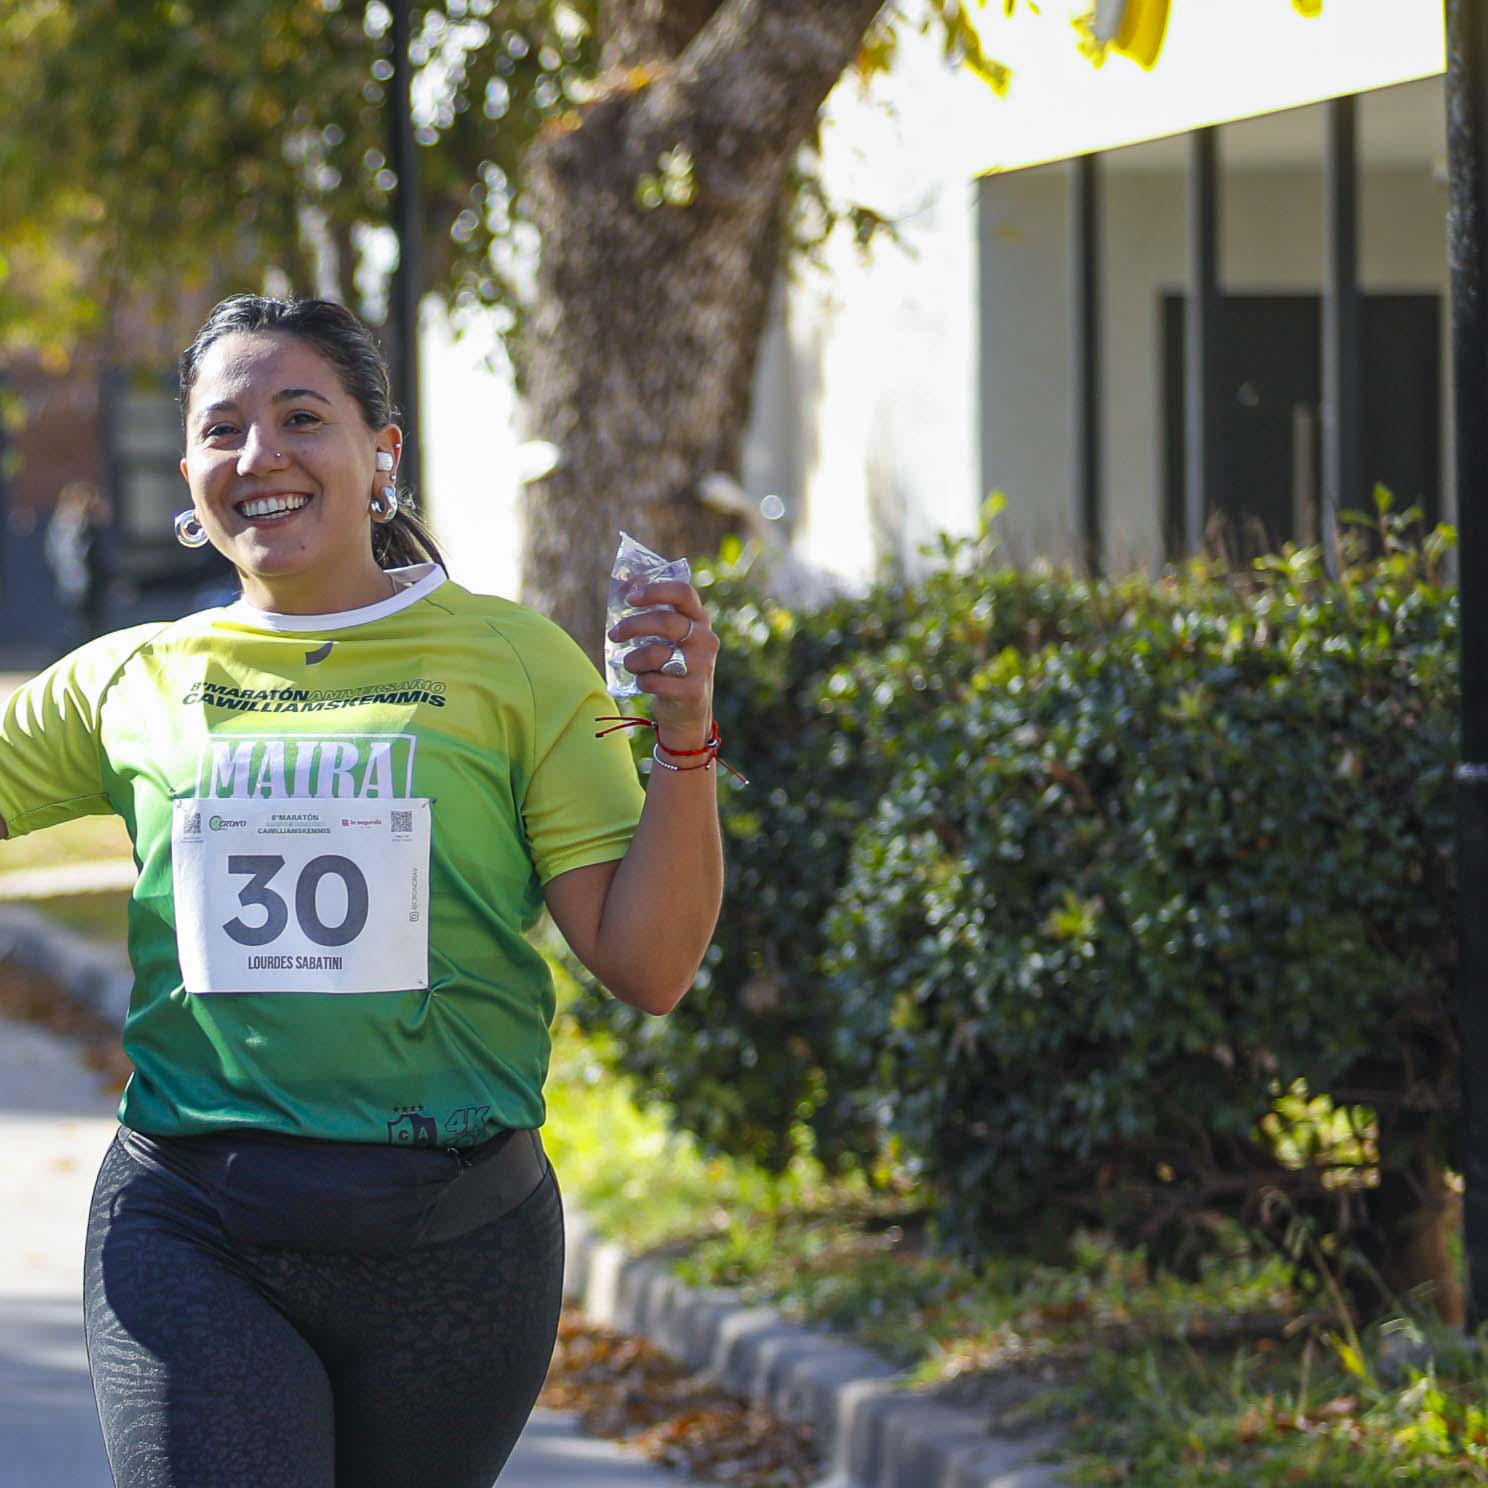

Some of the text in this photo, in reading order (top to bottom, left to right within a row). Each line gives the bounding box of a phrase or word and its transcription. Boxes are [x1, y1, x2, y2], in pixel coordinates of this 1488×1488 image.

[208, 741, 394, 799] MAIRA
[222, 854, 369, 947] 30
[247, 955, 343, 970] LOURDES SABATINI
